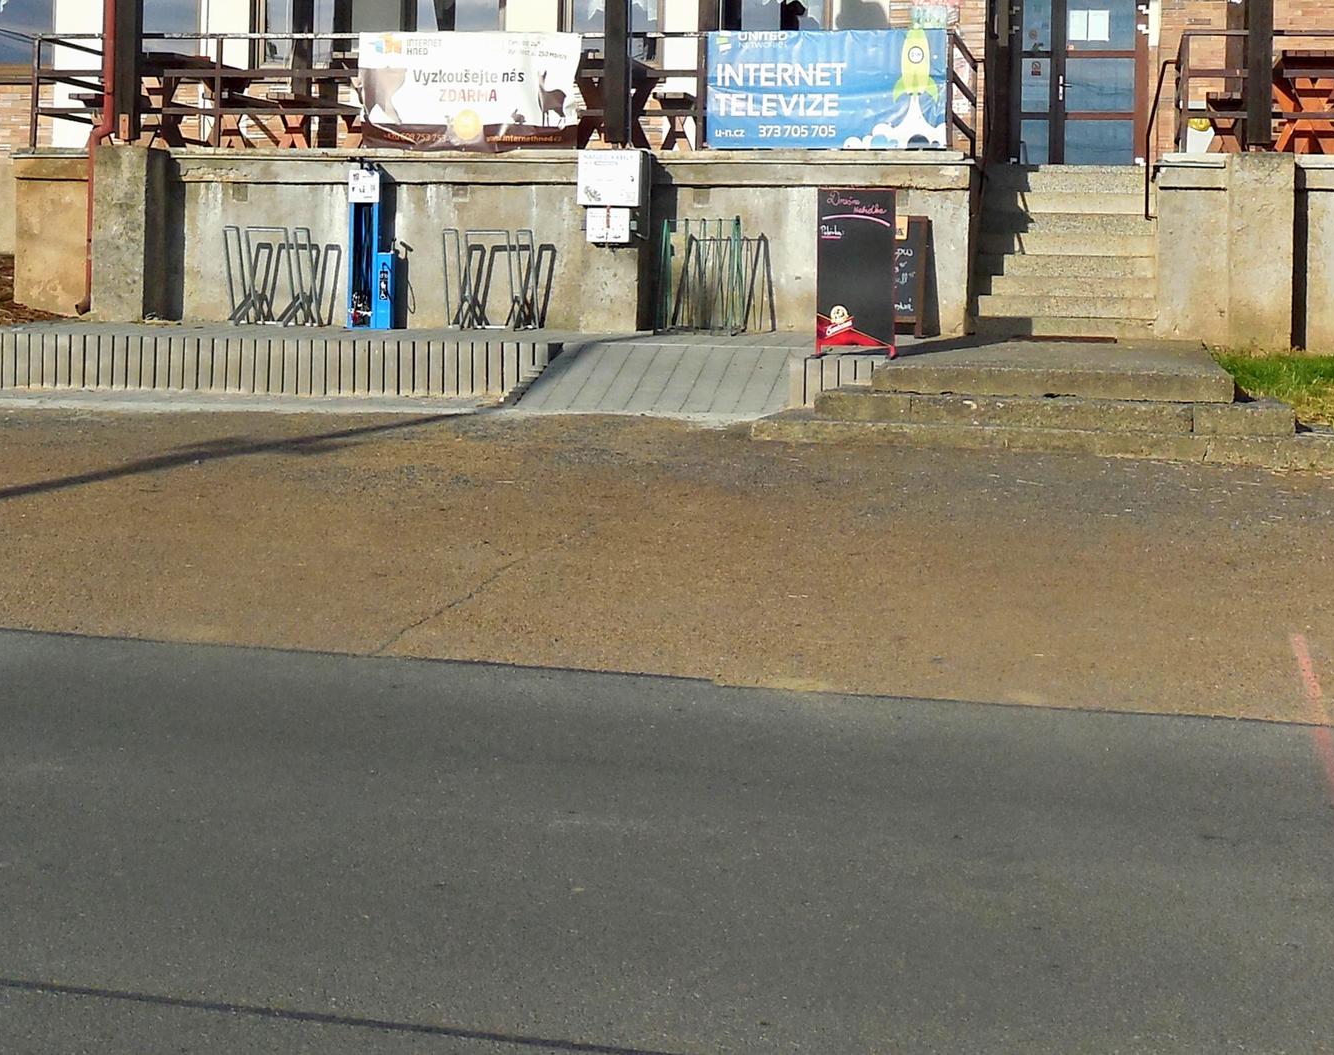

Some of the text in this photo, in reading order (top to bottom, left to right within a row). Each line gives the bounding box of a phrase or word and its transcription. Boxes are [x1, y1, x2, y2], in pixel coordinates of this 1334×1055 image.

[413, 68, 525, 86] Vyzkoušejte nás
[716, 62, 846, 87] INTERNET
[438, 88, 497, 102] ZDARMA
[715, 93, 839, 117] TELEVIZE
[715, 125, 836, 138] u-n.cz 373 705 705
